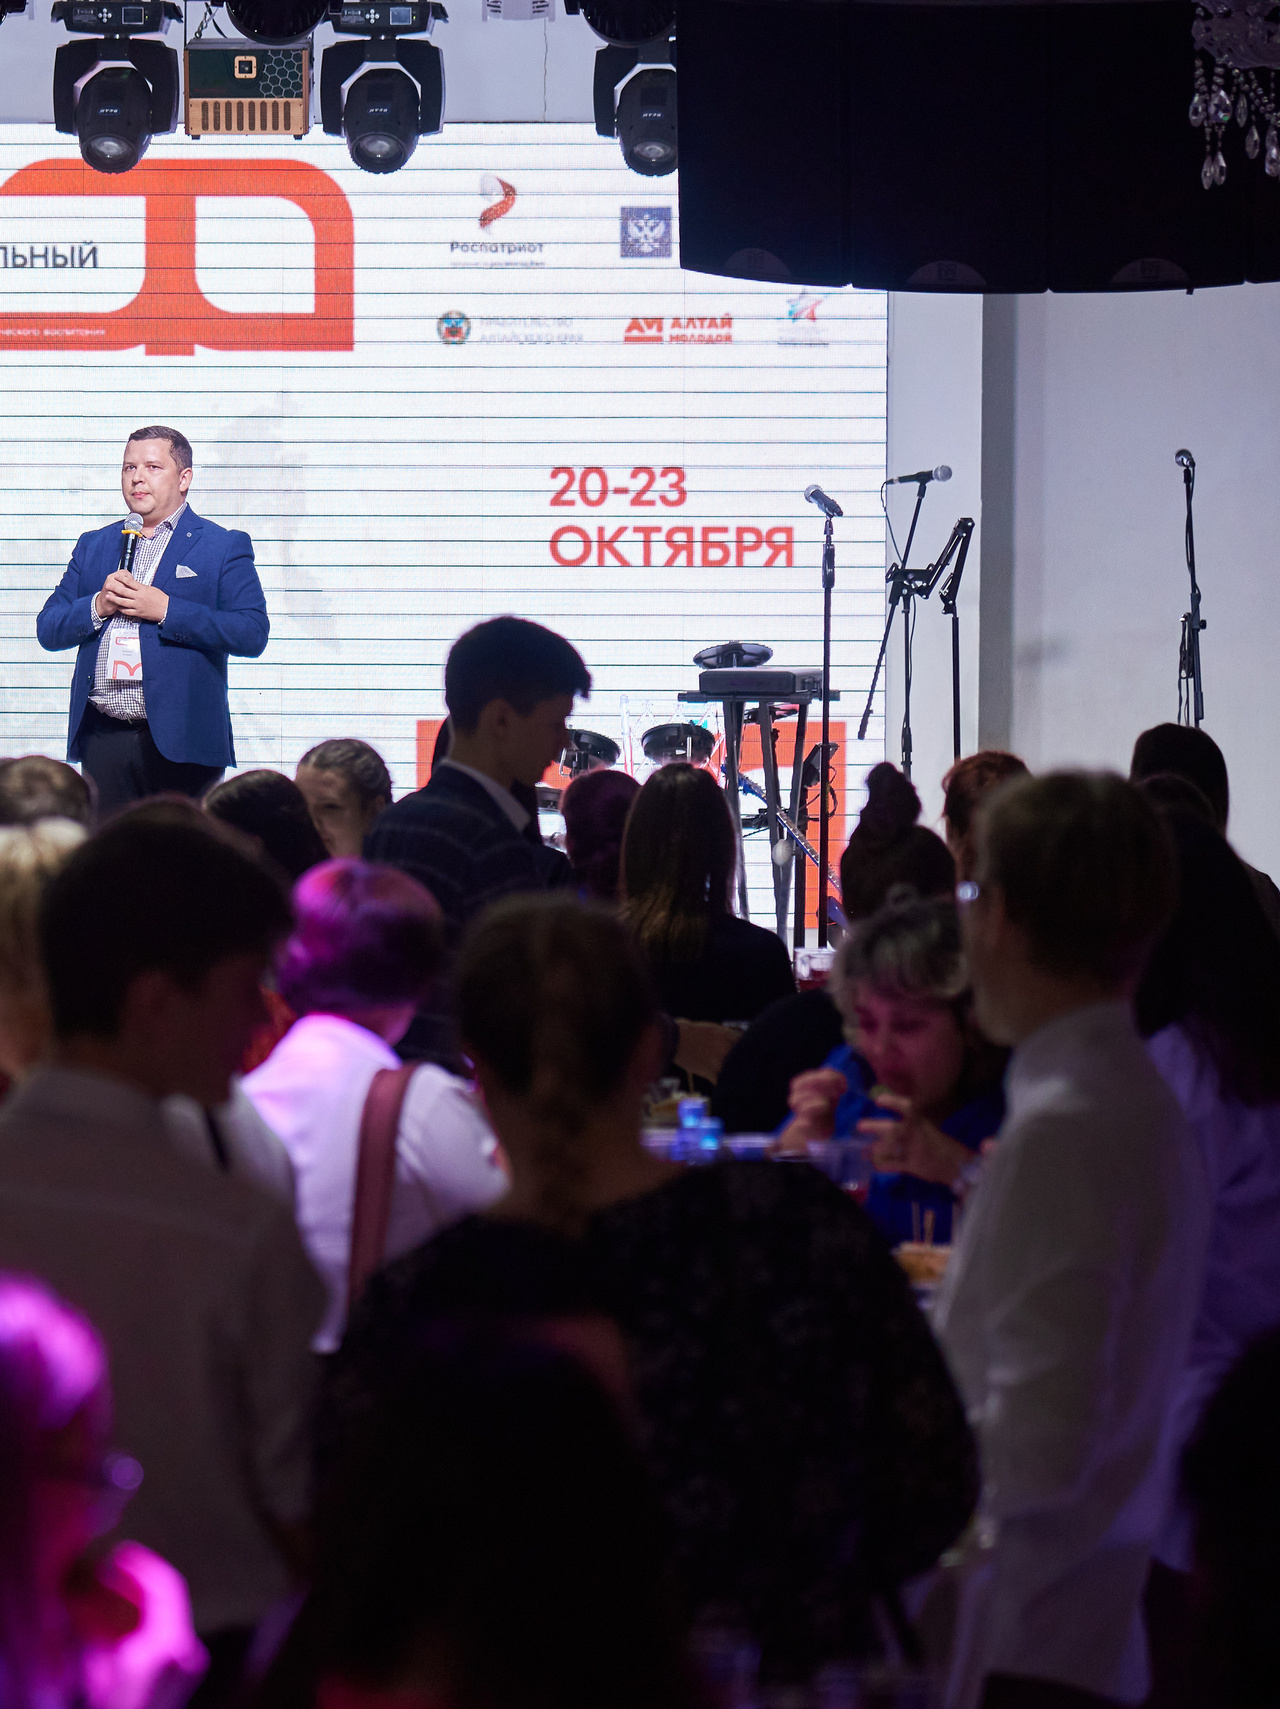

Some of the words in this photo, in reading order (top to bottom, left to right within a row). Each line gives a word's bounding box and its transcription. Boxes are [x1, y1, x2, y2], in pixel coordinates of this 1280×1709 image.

[450, 241, 545, 256] Роспатриот
[670, 313, 733, 329] АЛТАЙ
[669, 333, 733, 343] МОЛОДОЙ
[549, 465, 689, 508] 20-23
[549, 525, 795, 568] ОКТЯБРЯ
